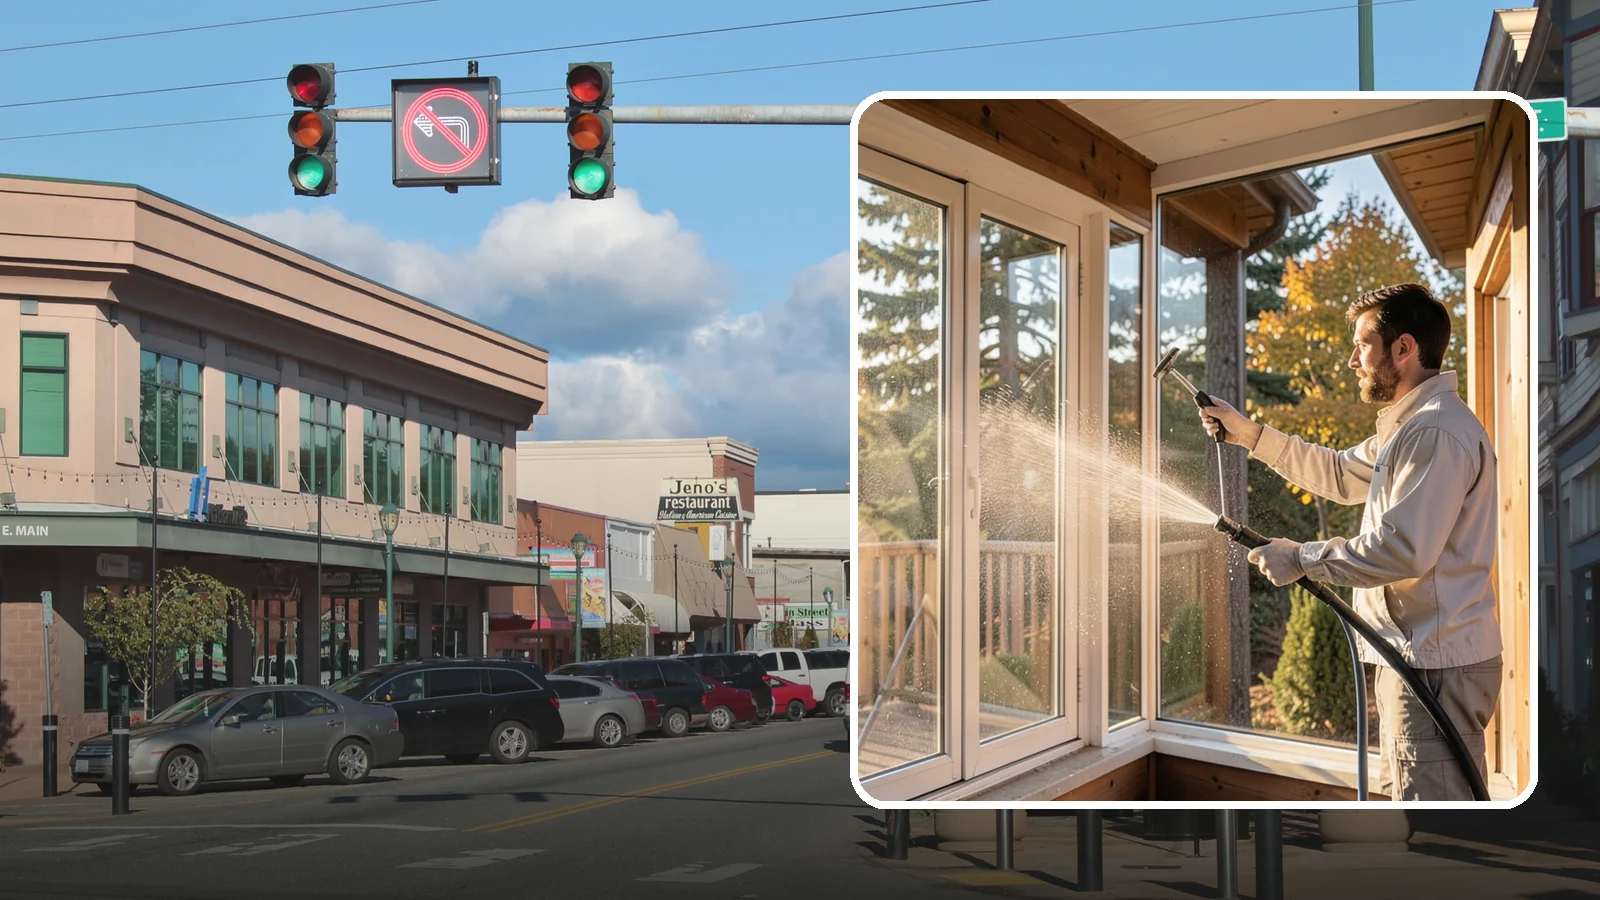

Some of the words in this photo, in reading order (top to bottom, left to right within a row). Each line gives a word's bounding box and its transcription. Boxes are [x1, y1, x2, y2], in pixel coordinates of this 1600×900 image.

[670, 480, 727, 494] Jeno's
[665, 496, 731, 509] restaurant
[659, 510, 681, 519] Italian
[686, 509, 714, 519] American
[715, 509, 738, 519] Cuisine
[2, 525, 13, 536] E.
[15, 525, 49, 536] MAIN
[797, 607, 828, 617] Street
